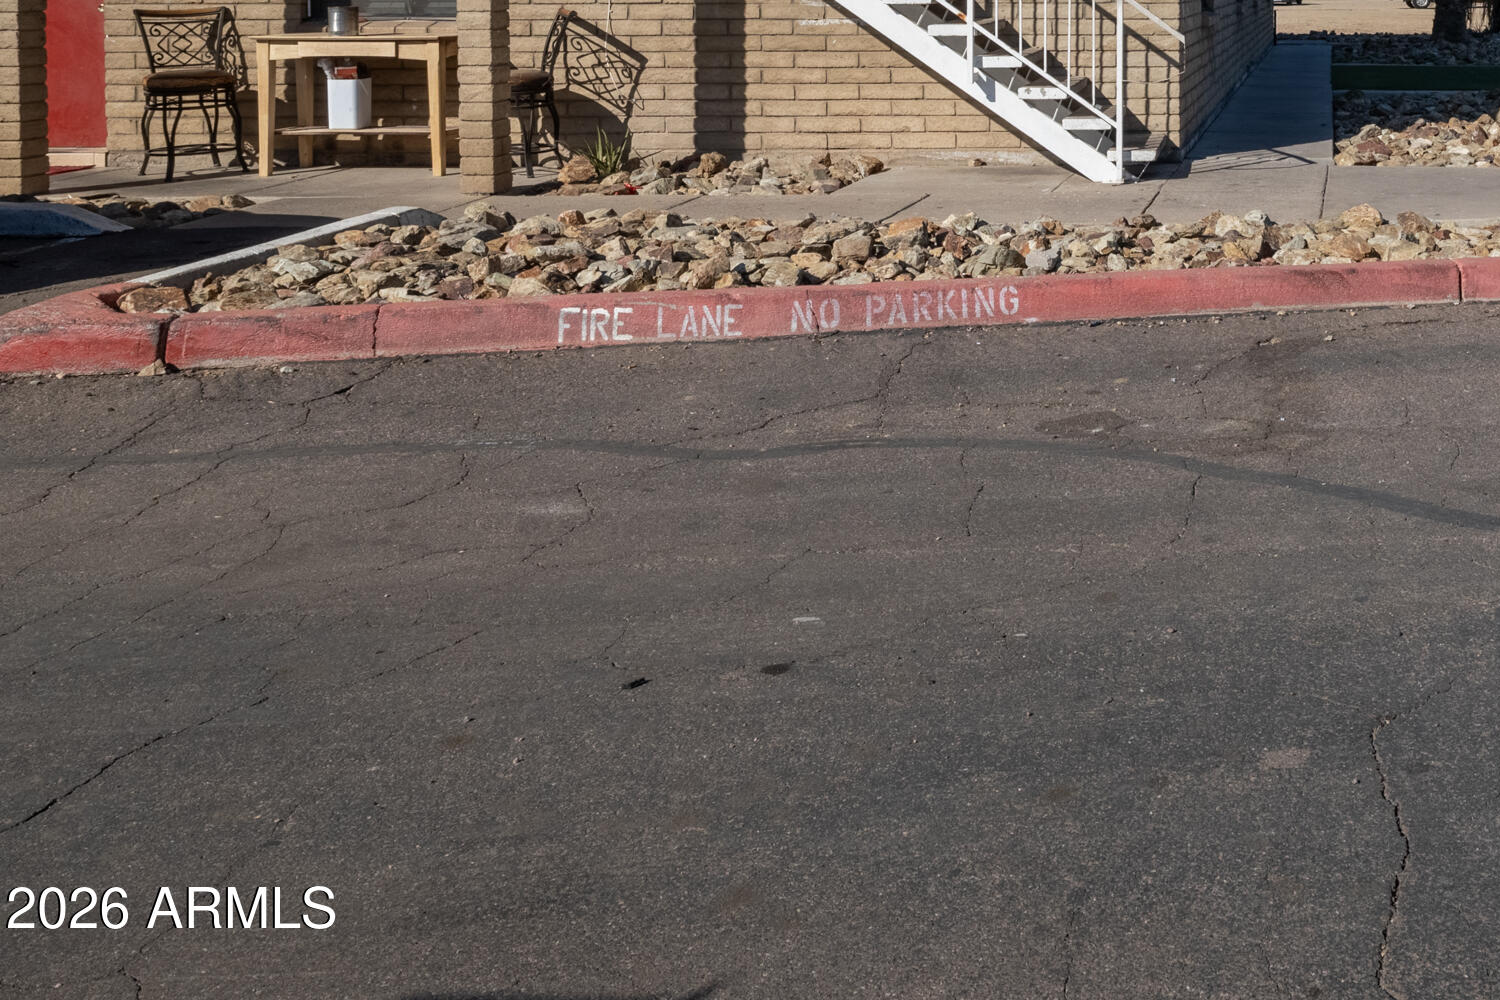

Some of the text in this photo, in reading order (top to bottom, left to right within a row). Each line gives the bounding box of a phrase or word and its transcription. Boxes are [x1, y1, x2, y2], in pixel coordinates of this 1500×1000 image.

[557, 284, 1020, 344] FIRE LANE NO PARKING
